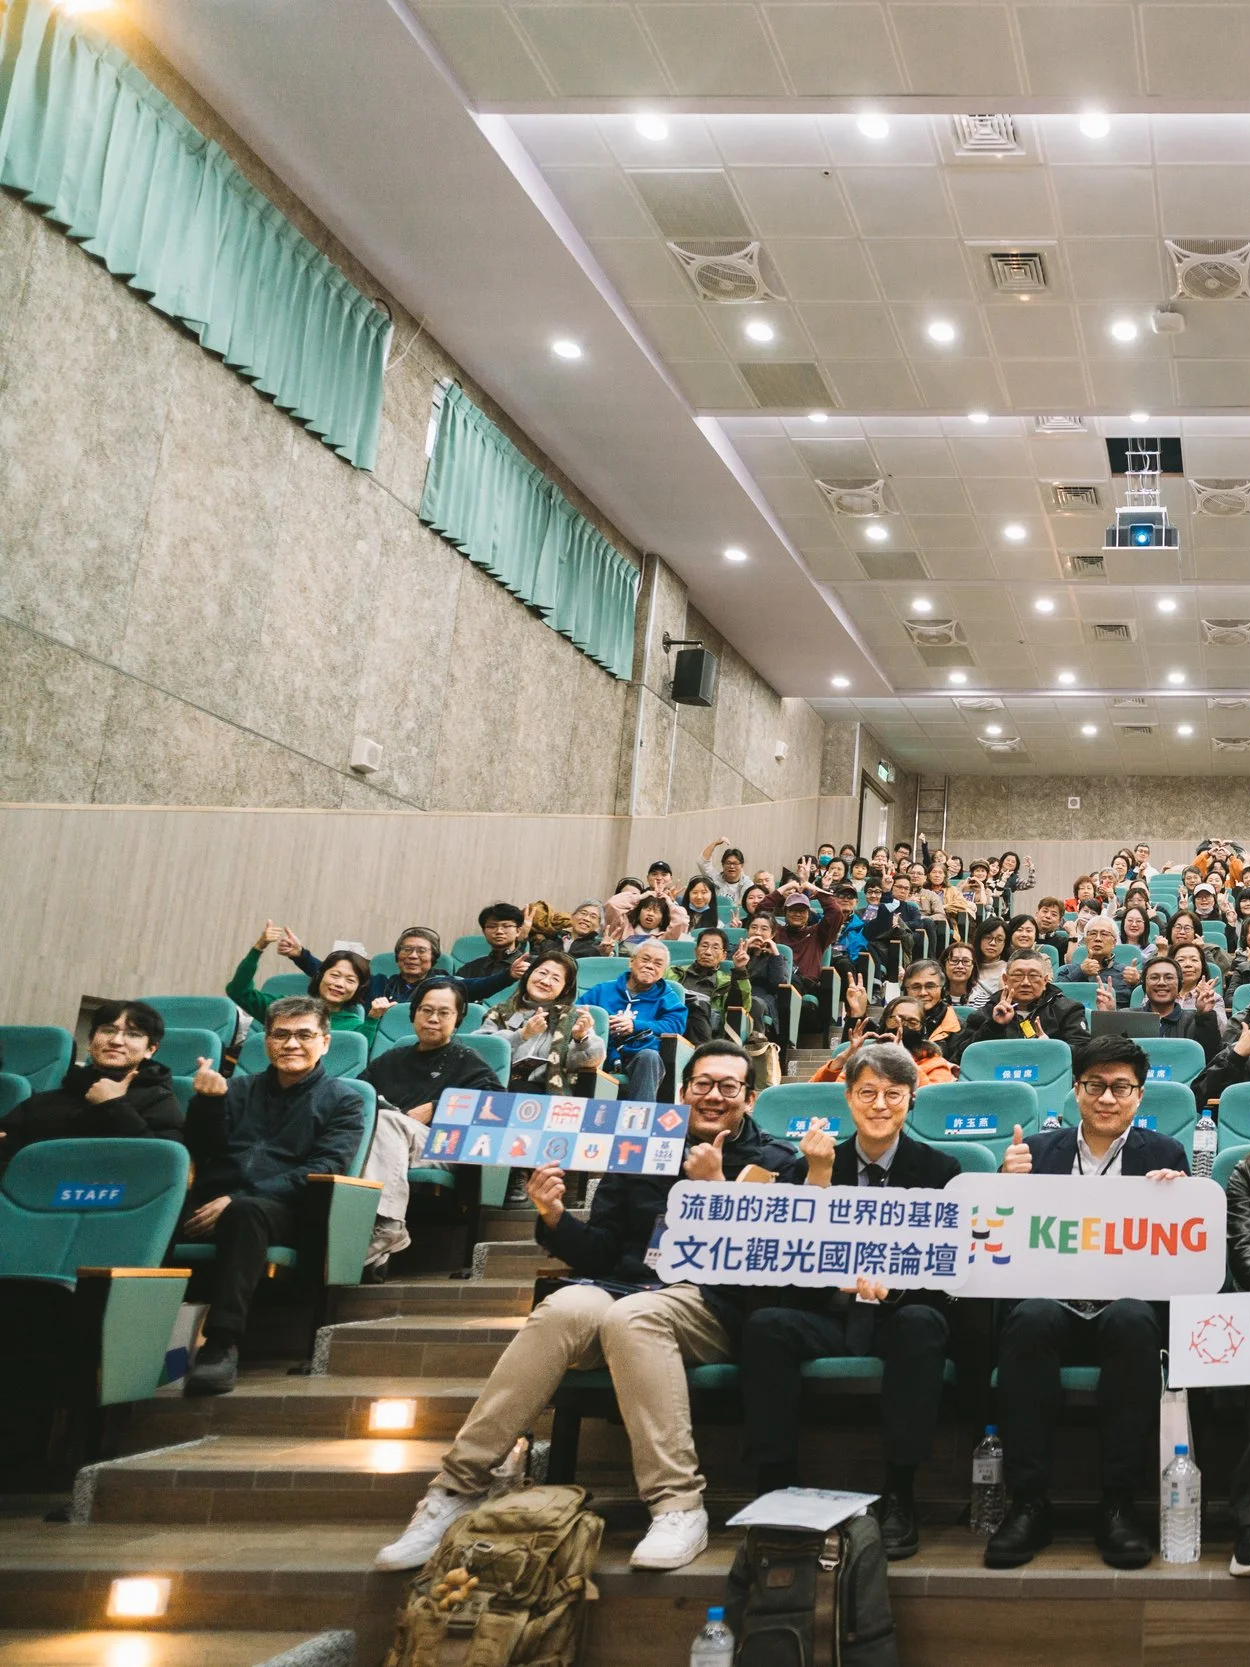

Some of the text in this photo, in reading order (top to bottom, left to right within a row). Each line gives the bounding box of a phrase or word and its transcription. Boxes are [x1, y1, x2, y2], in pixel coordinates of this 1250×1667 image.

[1002, 1069, 1033, 1080] 保留席
[953, 1117, 989, 1129] 許玉燕
[60, 1188, 121, 1201] STAFF
[679, 1193, 960, 1229] 流動的港口 世界的基隆
[1029, 1215, 1208, 1257] KEELUNG
[670, 1234, 959, 1277] 文化觀光國際論壇
